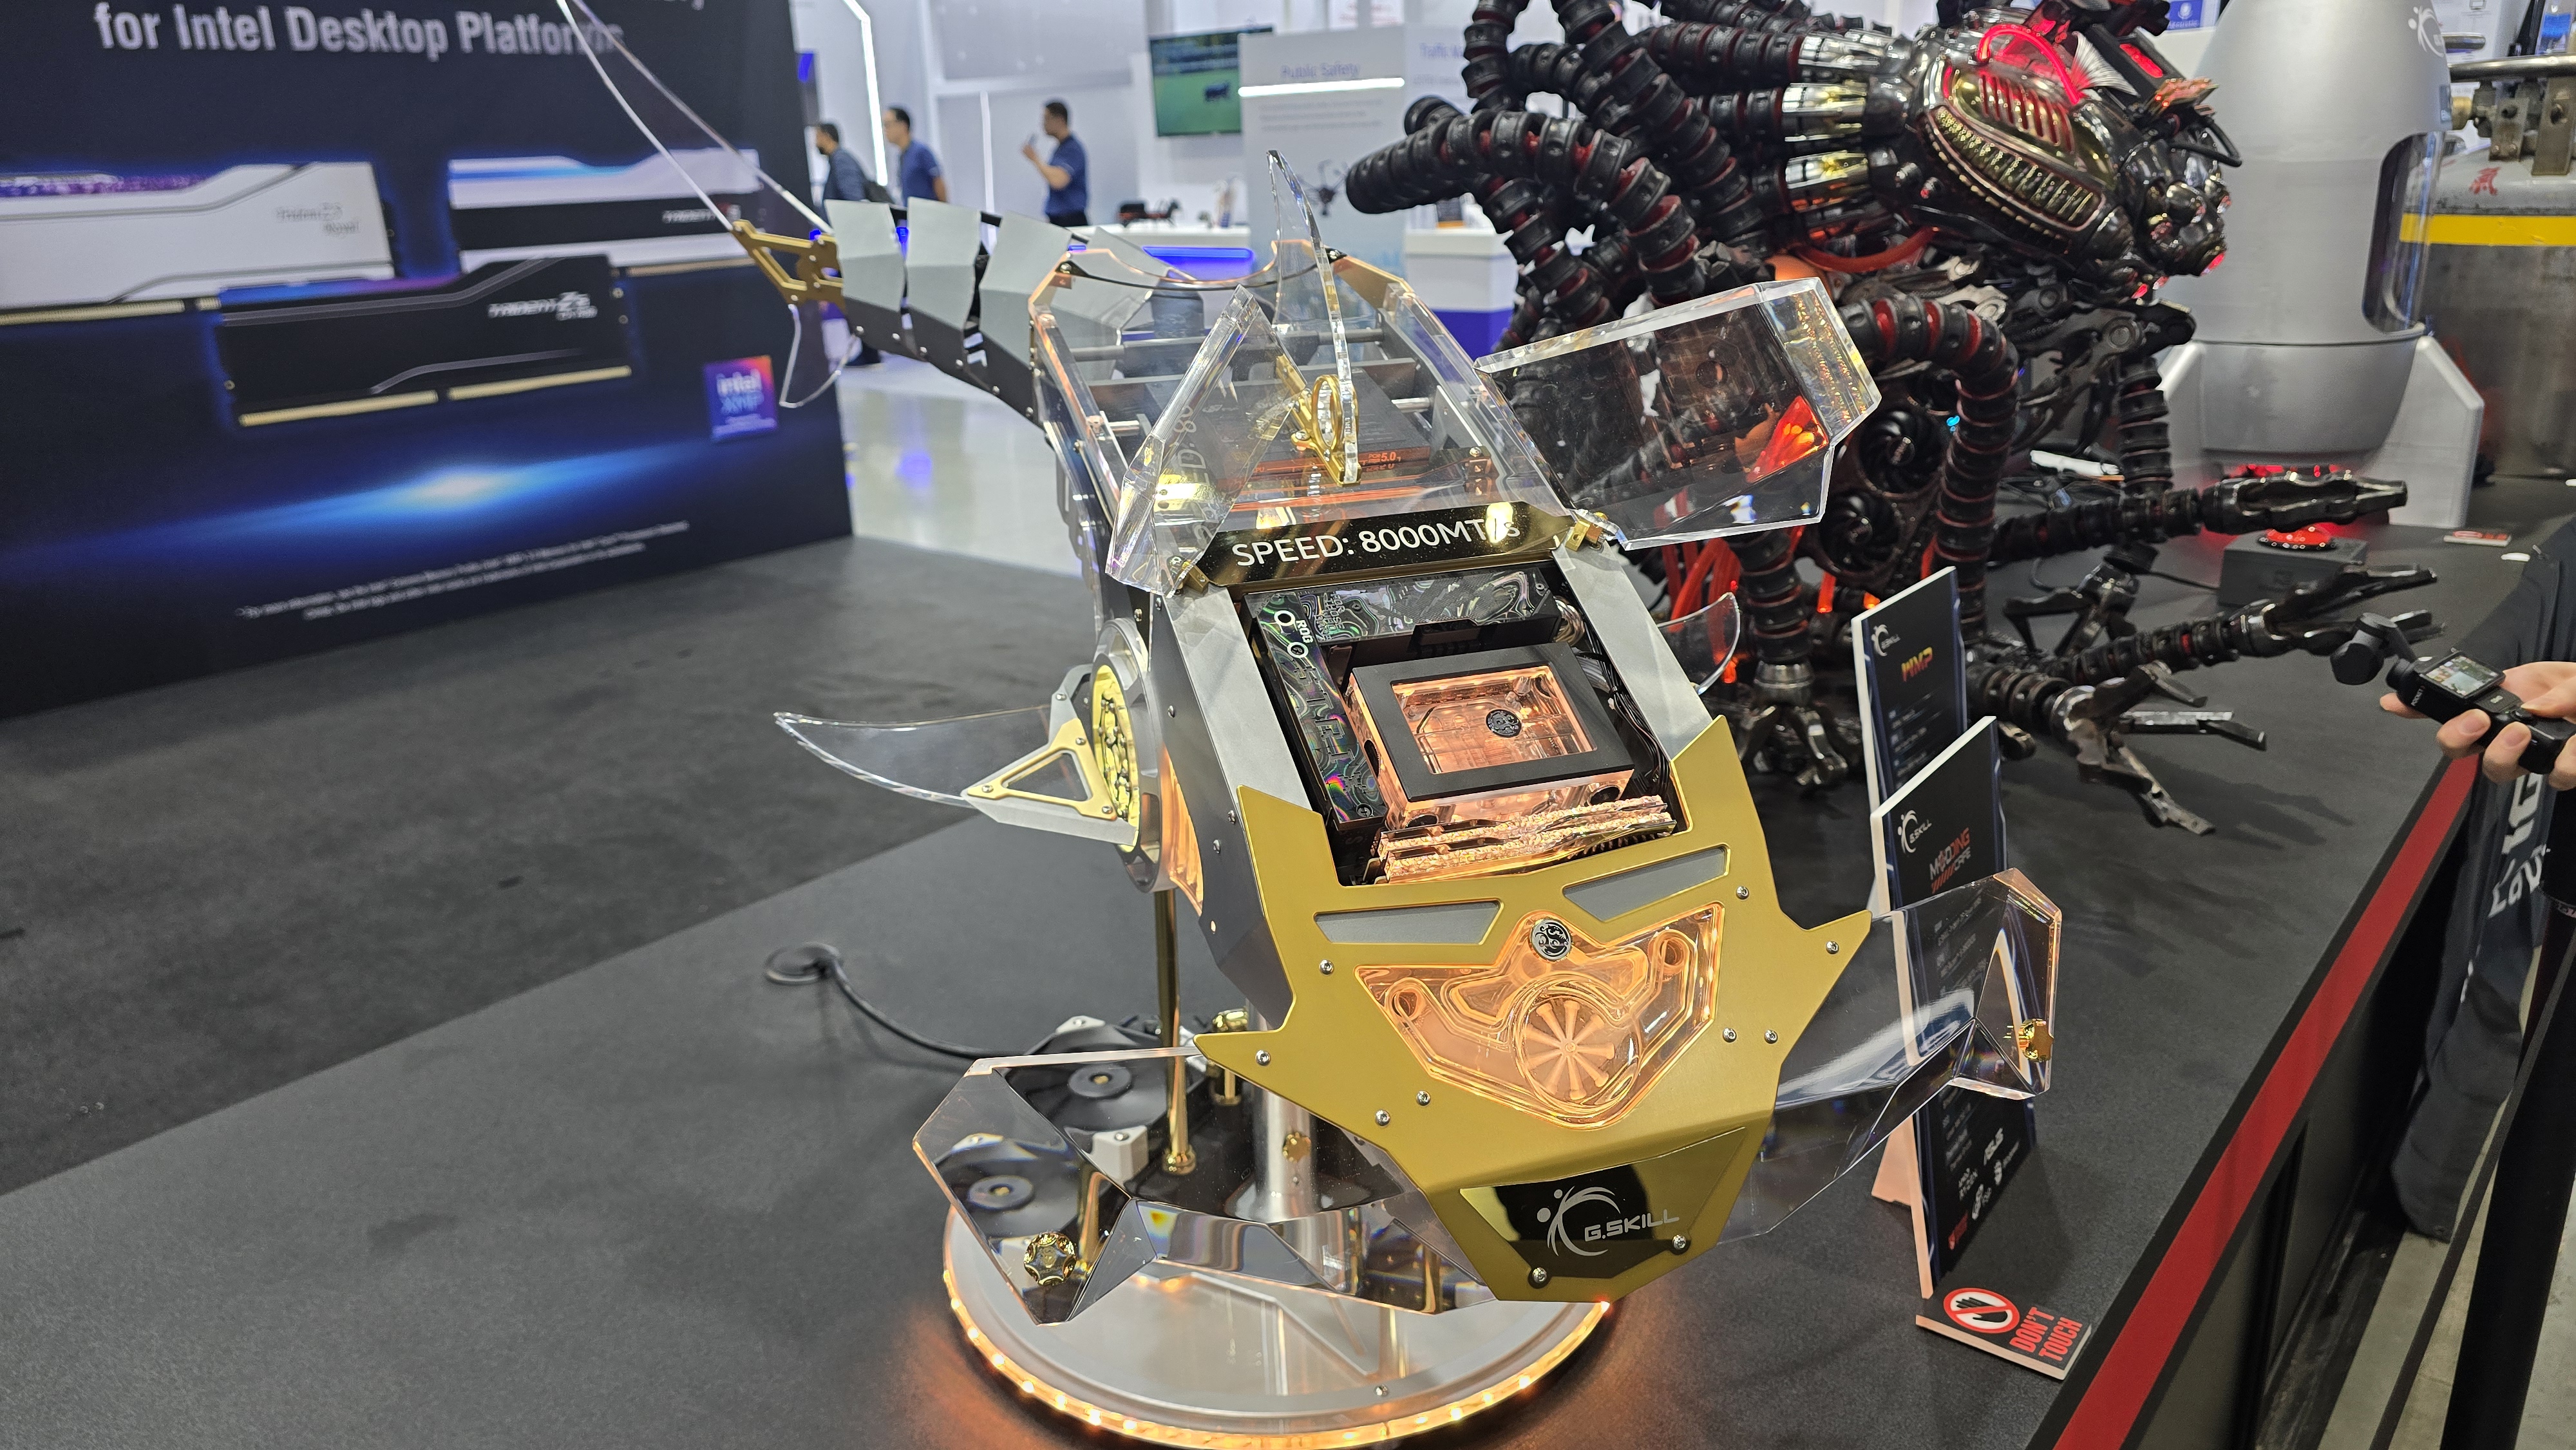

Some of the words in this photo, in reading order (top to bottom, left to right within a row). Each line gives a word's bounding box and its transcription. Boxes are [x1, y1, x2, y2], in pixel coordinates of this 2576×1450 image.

[95, 1, 161, 50] for
[173, 3, 276, 52] Intel
[284, 8, 449, 62] Desktop
[455, 10, 627, 57] Platforms
[717, 368, 762, 397] intel
[1381, 451, 1397, 462] 5.0
[1231, 533, 1354, 567] SPEED:
[1361, 517, 1520, 554] 8000MT/s
[1295, 619, 1314, 644] ROG
[1584, 1209, 1680, 1242] G.SKILL
[2009, 1306, 2052, 1352] DON'T
[2040, 1317, 2083, 1362] TOUCH
